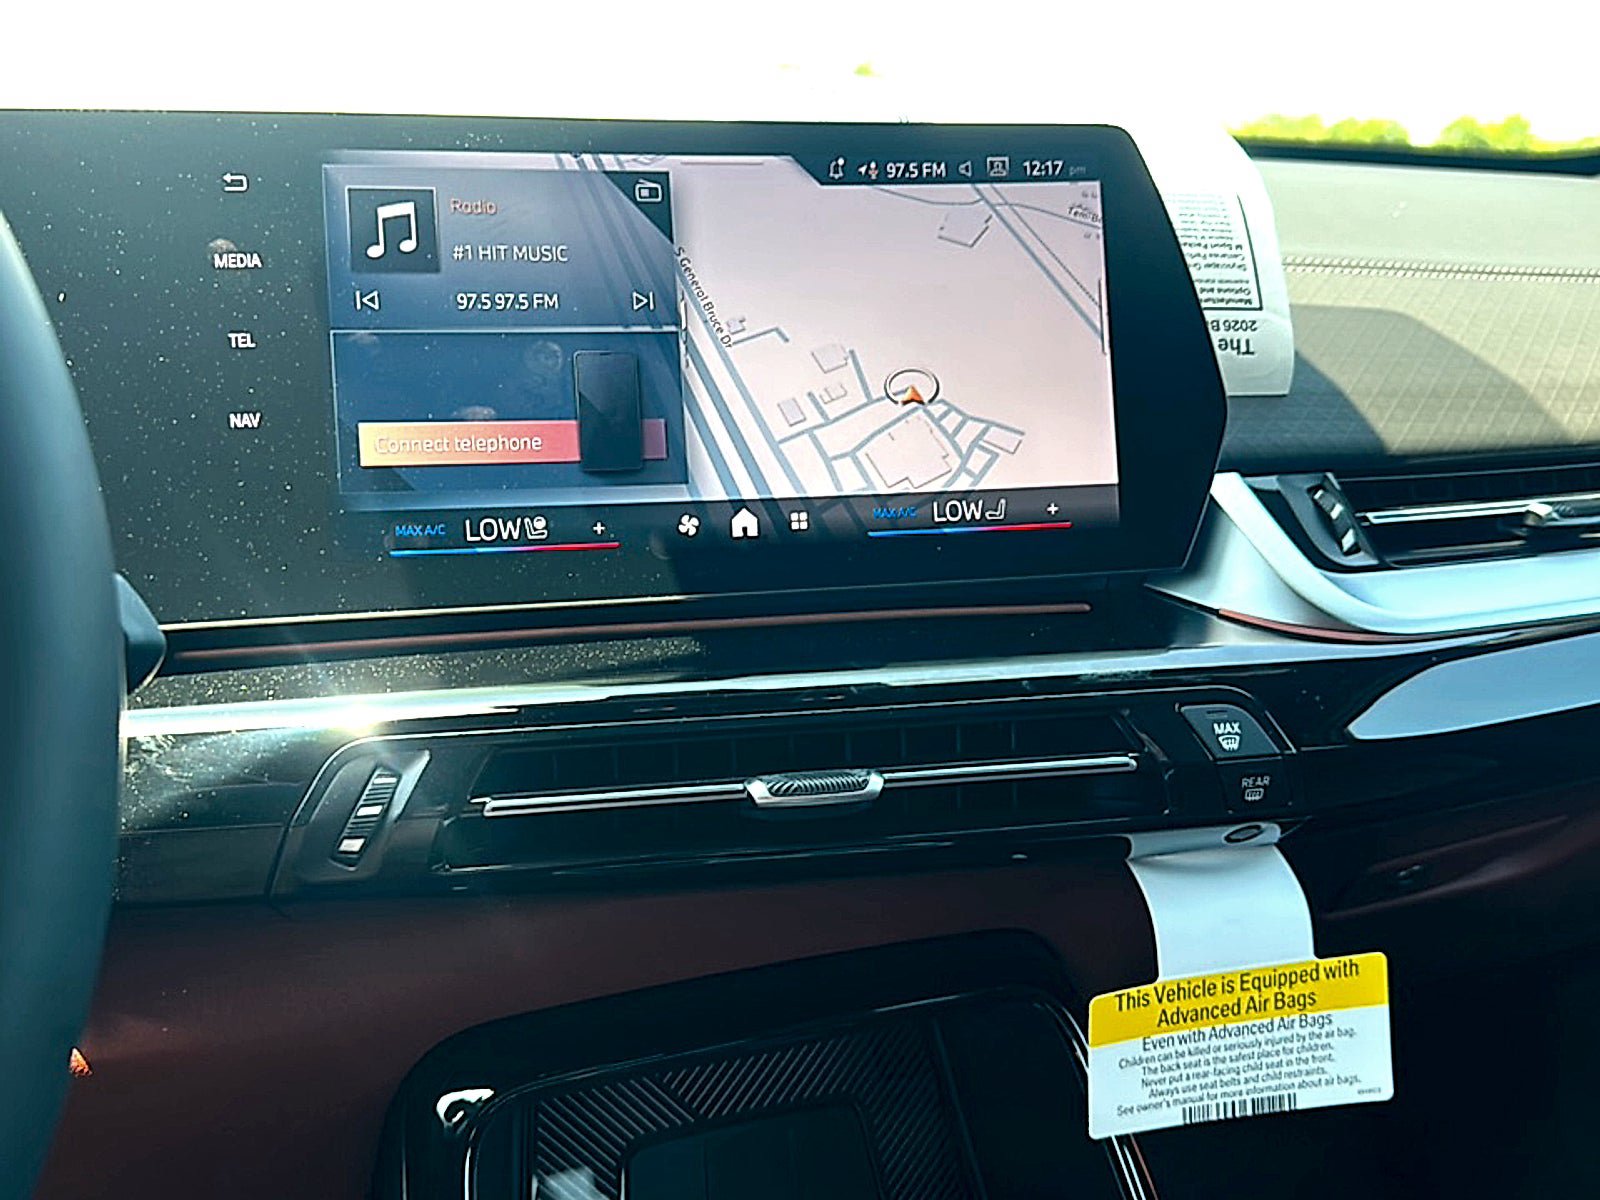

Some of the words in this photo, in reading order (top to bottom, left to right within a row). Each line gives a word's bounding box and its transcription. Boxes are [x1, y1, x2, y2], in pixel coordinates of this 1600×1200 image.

[886, 162, 918, 178] 97.5
[922, 161, 947, 178] FM
[1022, 160, 1064, 177] 12:17
[1069, 165, 1087, 176] pm
[450, 198, 497, 215] Radio
[213, 253, 263, 269] MEDIA
[453, 246, 474, 261] #1
[478, 245, 508, 262] HIT
[514, 246, 568, 263] MUSIC
[457, 294, 491, 310] 97.5
[495, 294, 529, 310] 97.5
[533, 294, 559, 310] FM
[674, 246, 685, 257] S
[680, 257, 709, 302] General
[703, 301, 724, 333] Bruce
[720, 335, 733, 348] Dr
[1200, 298, 1253, 306] Manufactur
[1206, 320, 1220, 332] B
[1223, 319, 1258, 332] 2026
[228, 333, 257, 348] TEL
[1217, 338, 1255, 356] The
[229, 413, 261, 429] NAV
[374, 436, 450, 454] Connect
[454, 435, 543, 454] telephone
[933, 499, 983, 523] LOW
[395, 525, 423, 537] MAX
[424, 524, 446, 536] A/C
[465, 517, 521, 542] LOW
[1213, 722, 1241, 734] MAX
[1242, 776, 1270, 788] REAR
[1114, 989, 1150, 1012] This
[1153, 979, 1217, 1004] Vehicle
[1221, 975, 1235, 994] is
[1240, 962, 1320, 993] Equipped
[1324, 959, 1360, 980] with
[1157, 997, 1241, 1028] Advanced
[1245, 994, 1270, 1014] Air
[1274, 991, 1317, 1012] Bags
[1142, 1036, 1175, 1052] Even
[1177, 1028, 1206, 1046] with
[1208, 1016, 1274, 1040] Advanced
[1277, 1016, 1296, 1031] Air
[1299, 1013, 1333, 1029] Bags
[1118, 1055, 1156, 1069] Children
[1157, 1052, 1173, 1062] can
[1175, 1050, 1186, 1059] be
[1188, 1044, 1211, 1056] killed
[1212, 1045, 1221, 1053] or
[1224, 1038, 1262, 1052] seriously
[1264, 1033, 1294, 1047] injured
[1296, 1032, 1306, 1043] by
[1308, 1030, 1322, 1041] the
[1325, 1029, 1335, 1039] air
[1142, 1066, 1158, 1076] The
[1160, 1061, 1181, 1073] back
[1183, 1058, 1201, 1069] seat
[1203, 1058, 1211, 1067] is
[1212, 1055, 1227, 1065] the
[1229, 1051, 1255, 1063] safest
[1257, 1048, 1281, 1060] place
[1282, 1046, 1294, 1055] for
[1142, 1077, 1166, 1088] Never
[1168, 1073, 1183, 1085] put
[1242, 1061, 1263, 1073] child
[1265, 1058, 1283, 1070] seat
[1285, 1058, 1294, 1067] in
[1295, 1056, 1309, 1066] the
[1148, 1087, 1180, 1099] Always
[1181, 1084, 1197, 1094] use
[1199, 1079, 1218, 1091] seat
[1243, 1073, 1259, 1085] and
[1261, 1070, 1282, 1082] child
[1117, 1104, 1134, 1116] See
[1172, 1093, 1204, 1106] manual
[1206, 1091, 1218, 1101] for
[1220, 1089, 1243, 1099] more
[1246, 1082, 1296, 1096] information
[1297, 1077, 1322, 1089] about
[1324, 1076, 1335, 1086] air
